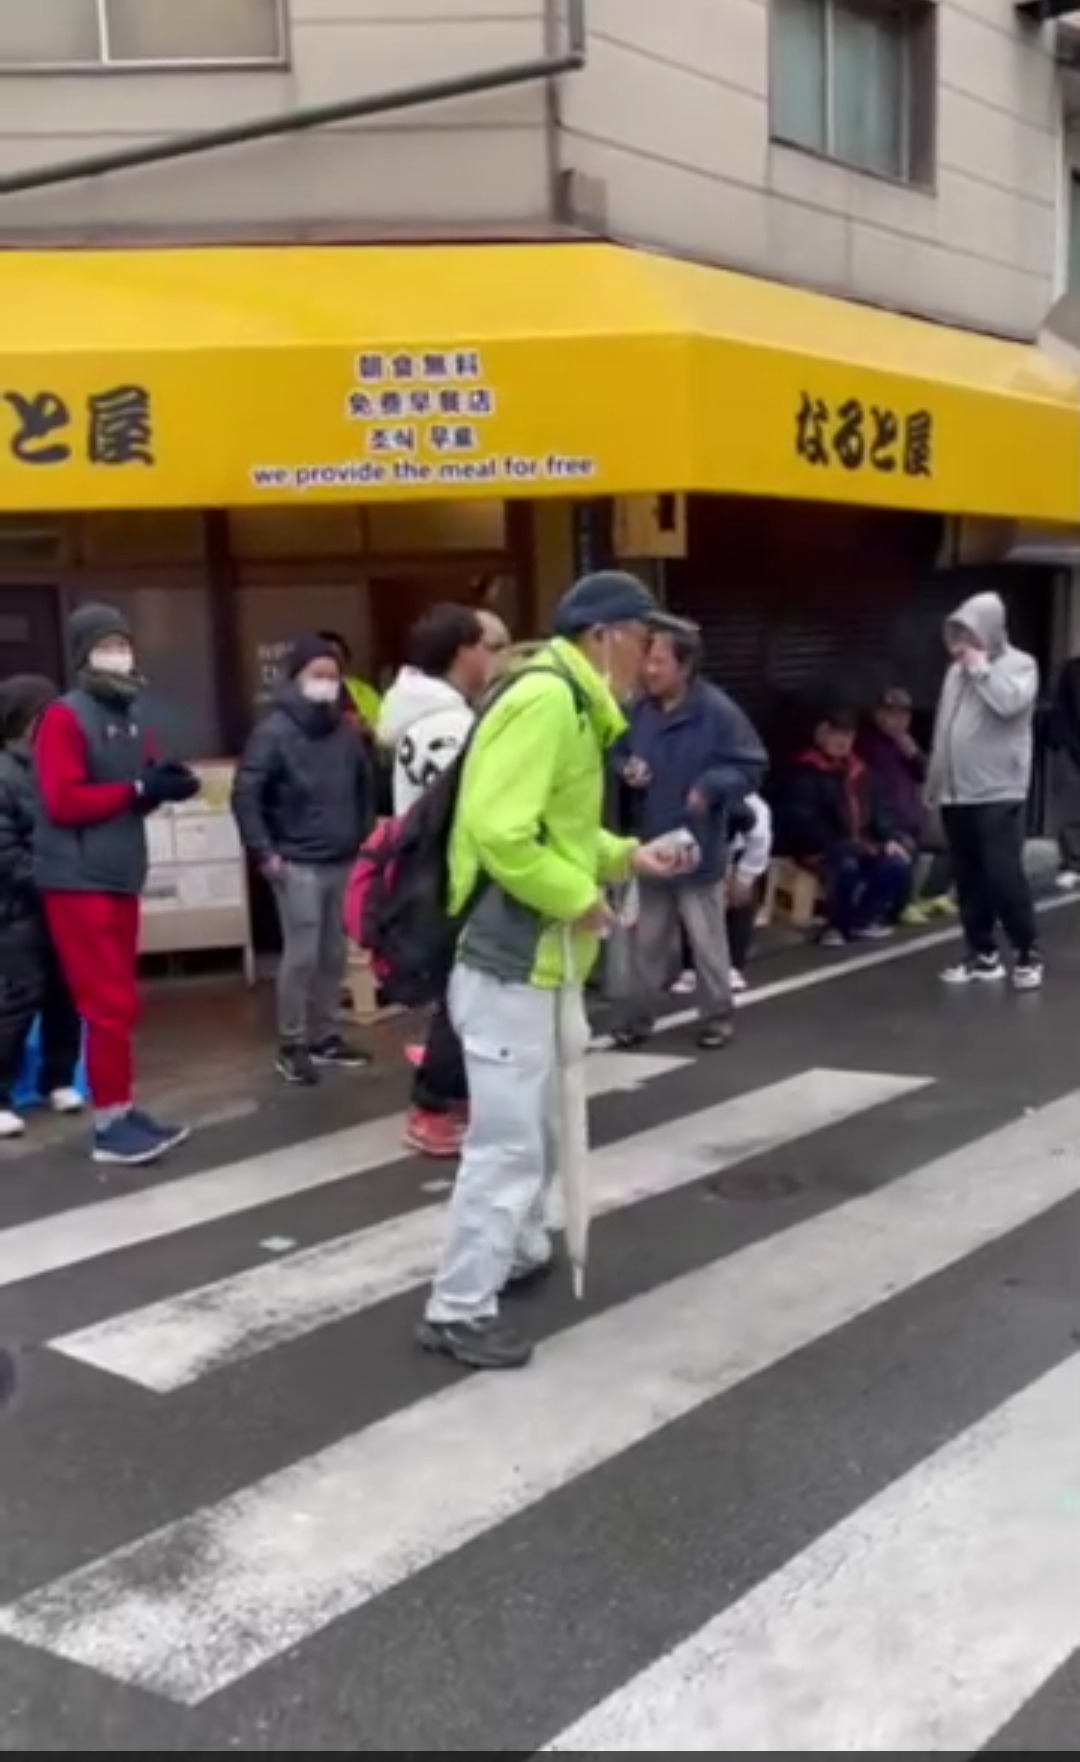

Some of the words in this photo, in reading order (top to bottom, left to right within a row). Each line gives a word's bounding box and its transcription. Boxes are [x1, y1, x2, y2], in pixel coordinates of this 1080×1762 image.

[3, 384, 155, 467] と屋
[795, 388, 932, 479] なると屋
[253, 465, 287, 483] we
[296, 458, 385, 487] provide
[394, 456, 431, 479] the
[440, 458, 496, 479] meal
[504, 456, 537, 476] for
[547, 454, 593, 475] free
